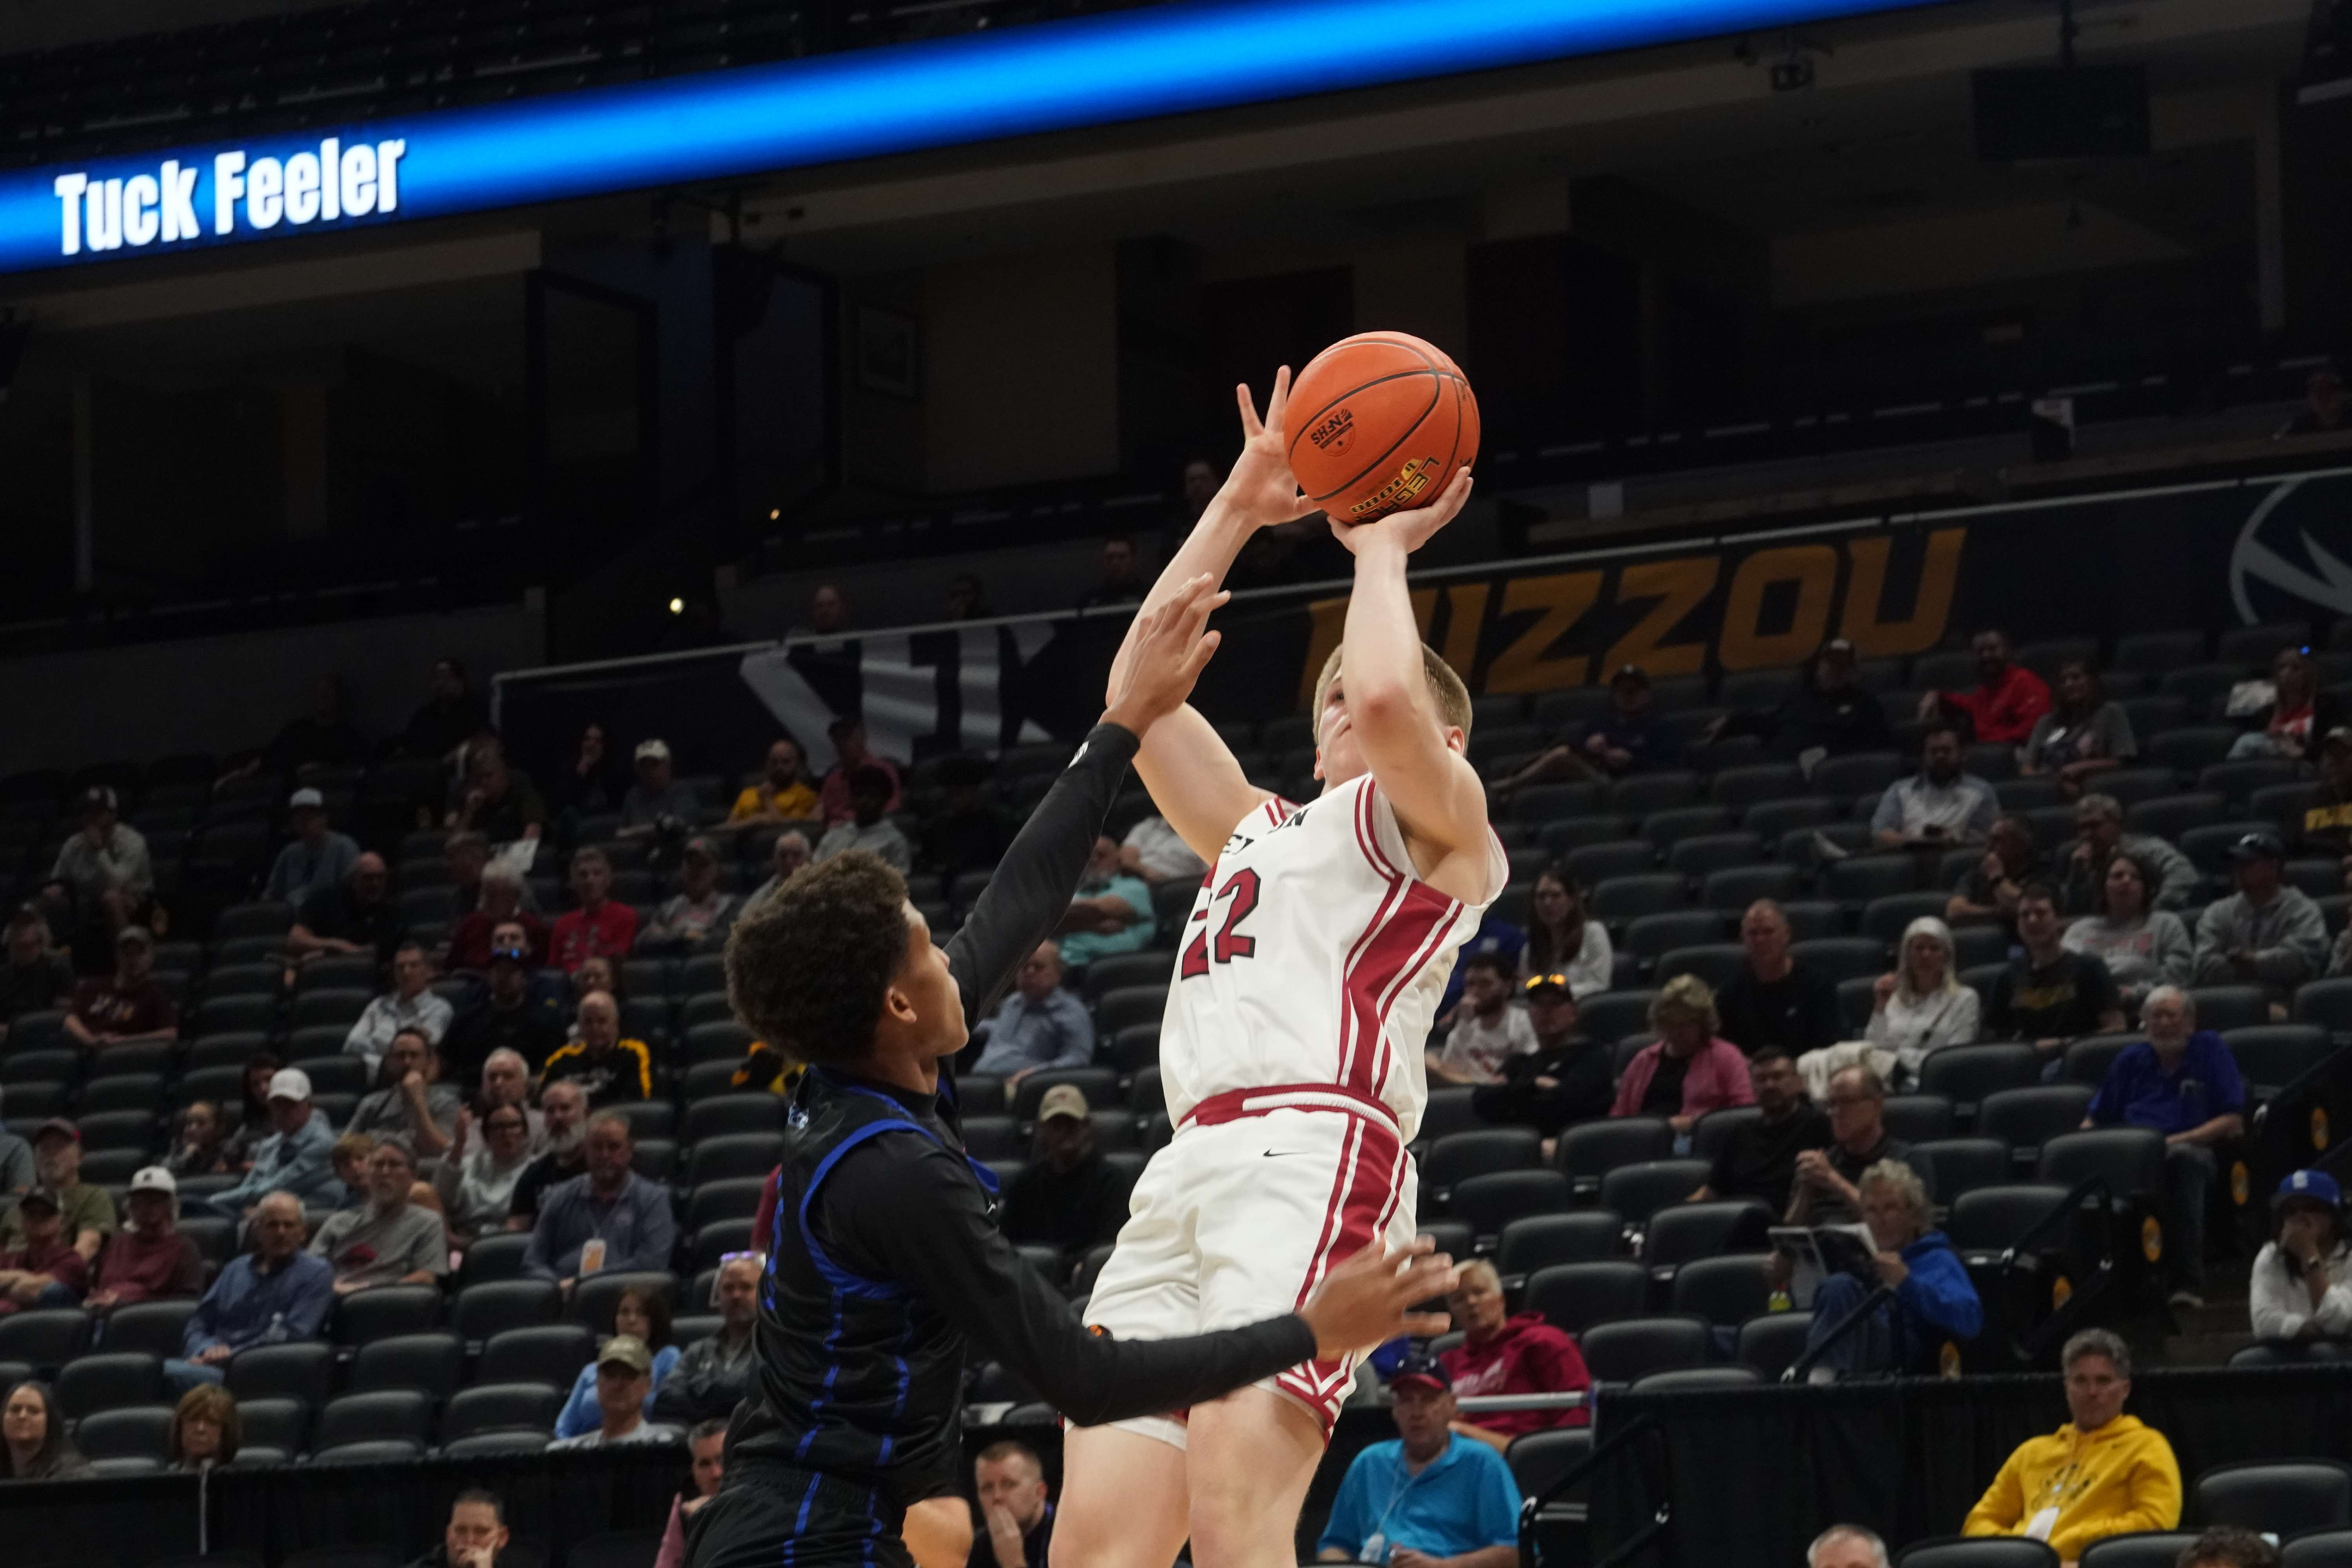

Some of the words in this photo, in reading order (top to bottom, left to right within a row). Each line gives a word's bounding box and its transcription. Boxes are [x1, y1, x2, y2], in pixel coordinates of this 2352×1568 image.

[54, 160, 201, 256] Tuck
[214, 137, 406, 235] Feeler
[1310, 414, 1343, 445] NFHS
[1181, 867, 1261, 981] 22
